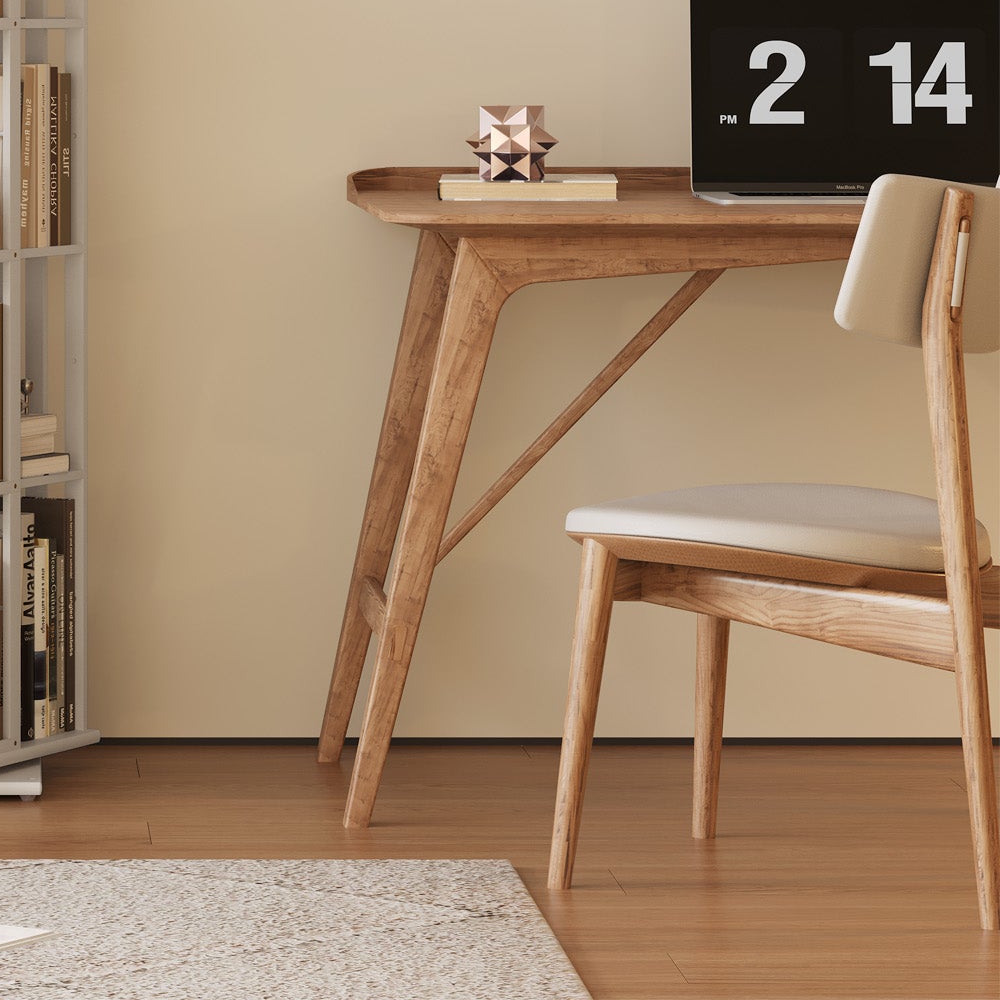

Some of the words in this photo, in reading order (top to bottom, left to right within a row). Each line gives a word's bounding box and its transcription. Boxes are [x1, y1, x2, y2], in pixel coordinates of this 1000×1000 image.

[749, 40, 806, 125] 2
[869, 41, 973, 125] 14
[719, 114, 738, 124] PM
[23, 523, 36, 571] Aalto
[23, 573, 35, 619] Alvar
